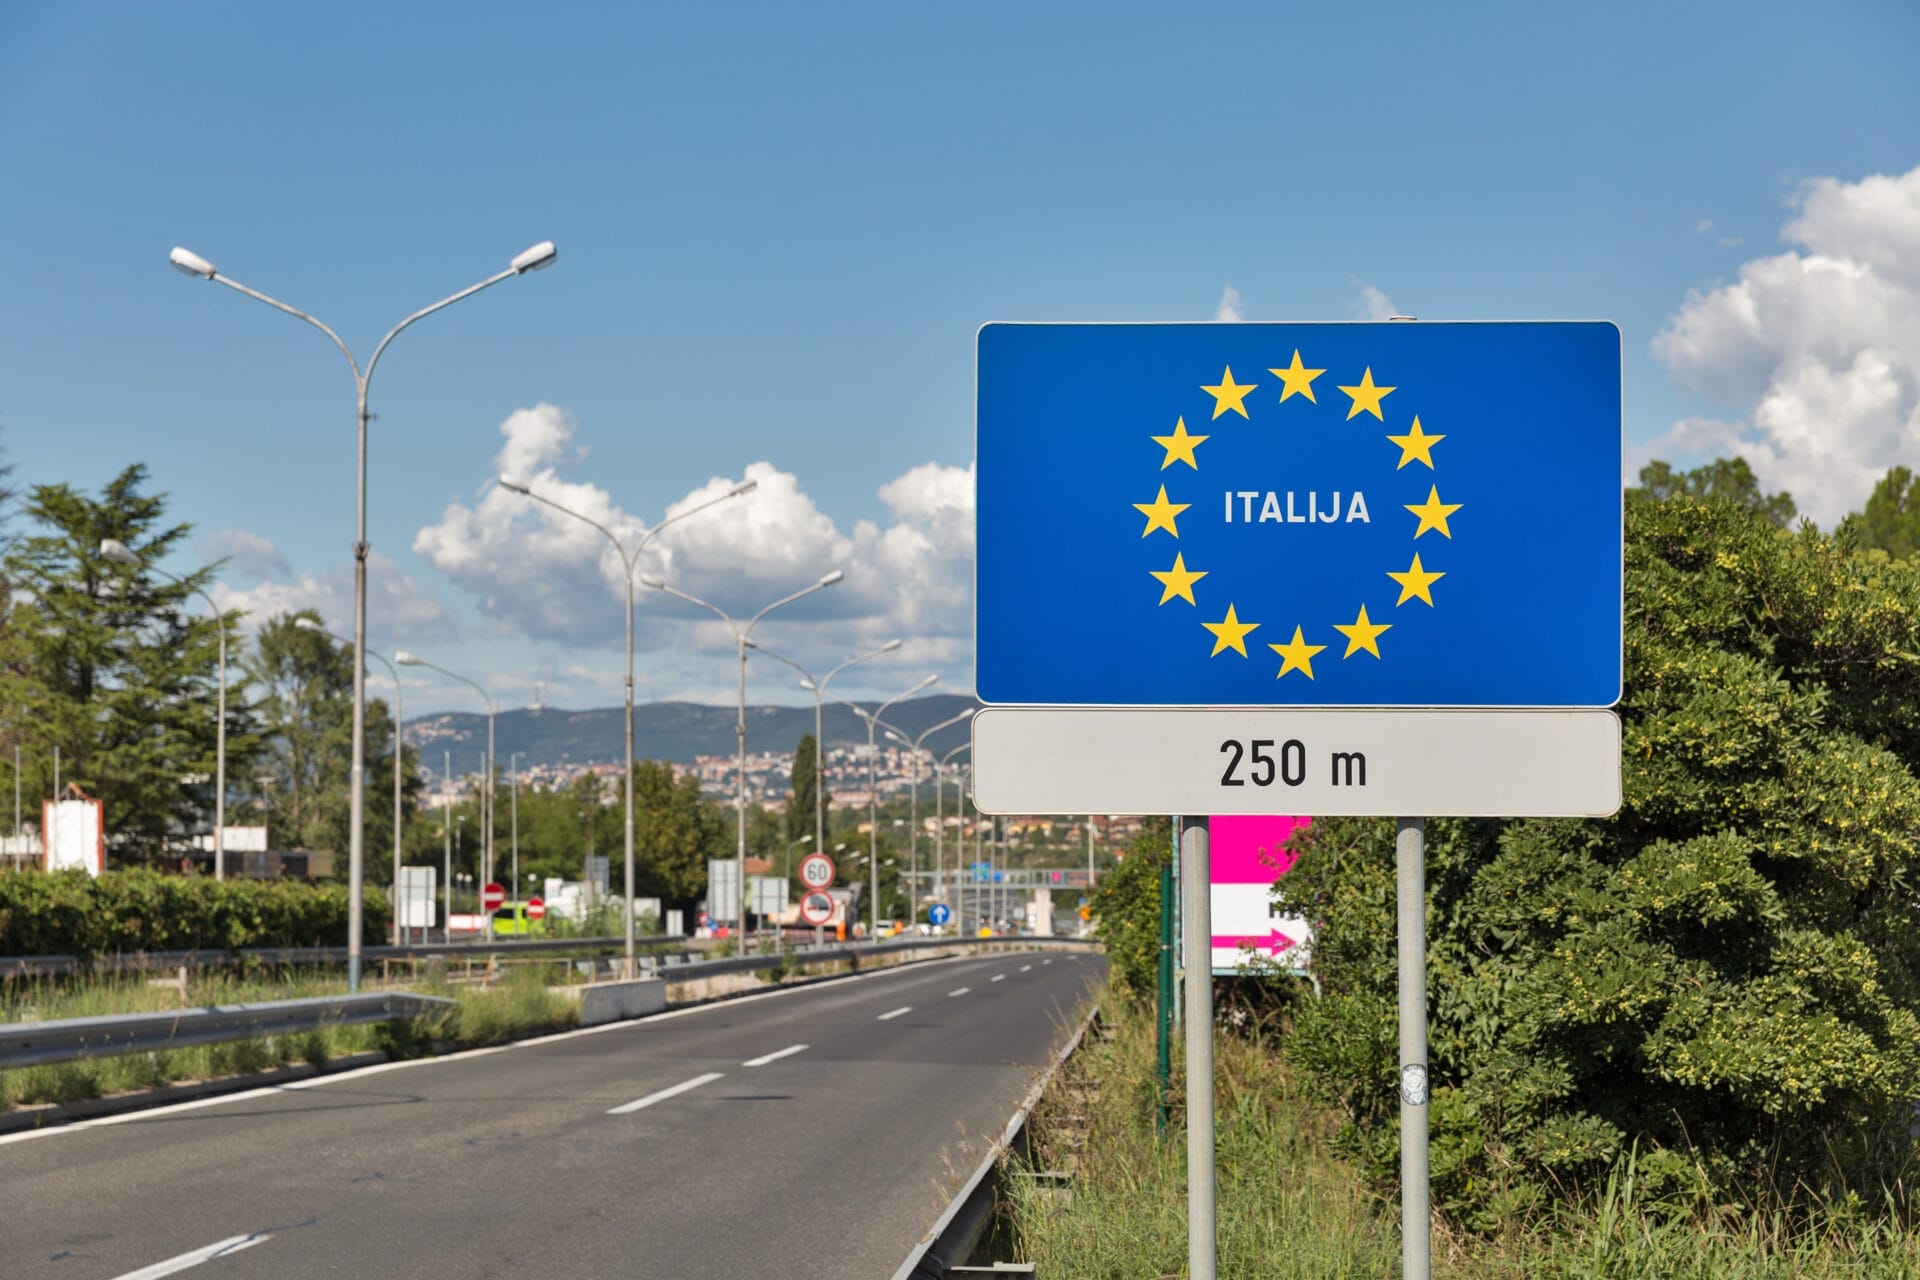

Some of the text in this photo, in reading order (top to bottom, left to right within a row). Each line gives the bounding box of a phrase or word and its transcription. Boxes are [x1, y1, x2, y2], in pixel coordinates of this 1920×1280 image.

[1225, 491, 1371, 523] ITALIJA
[1220, 739, 1366, 787] 250 m
[807, 864, 828, 880] 60
